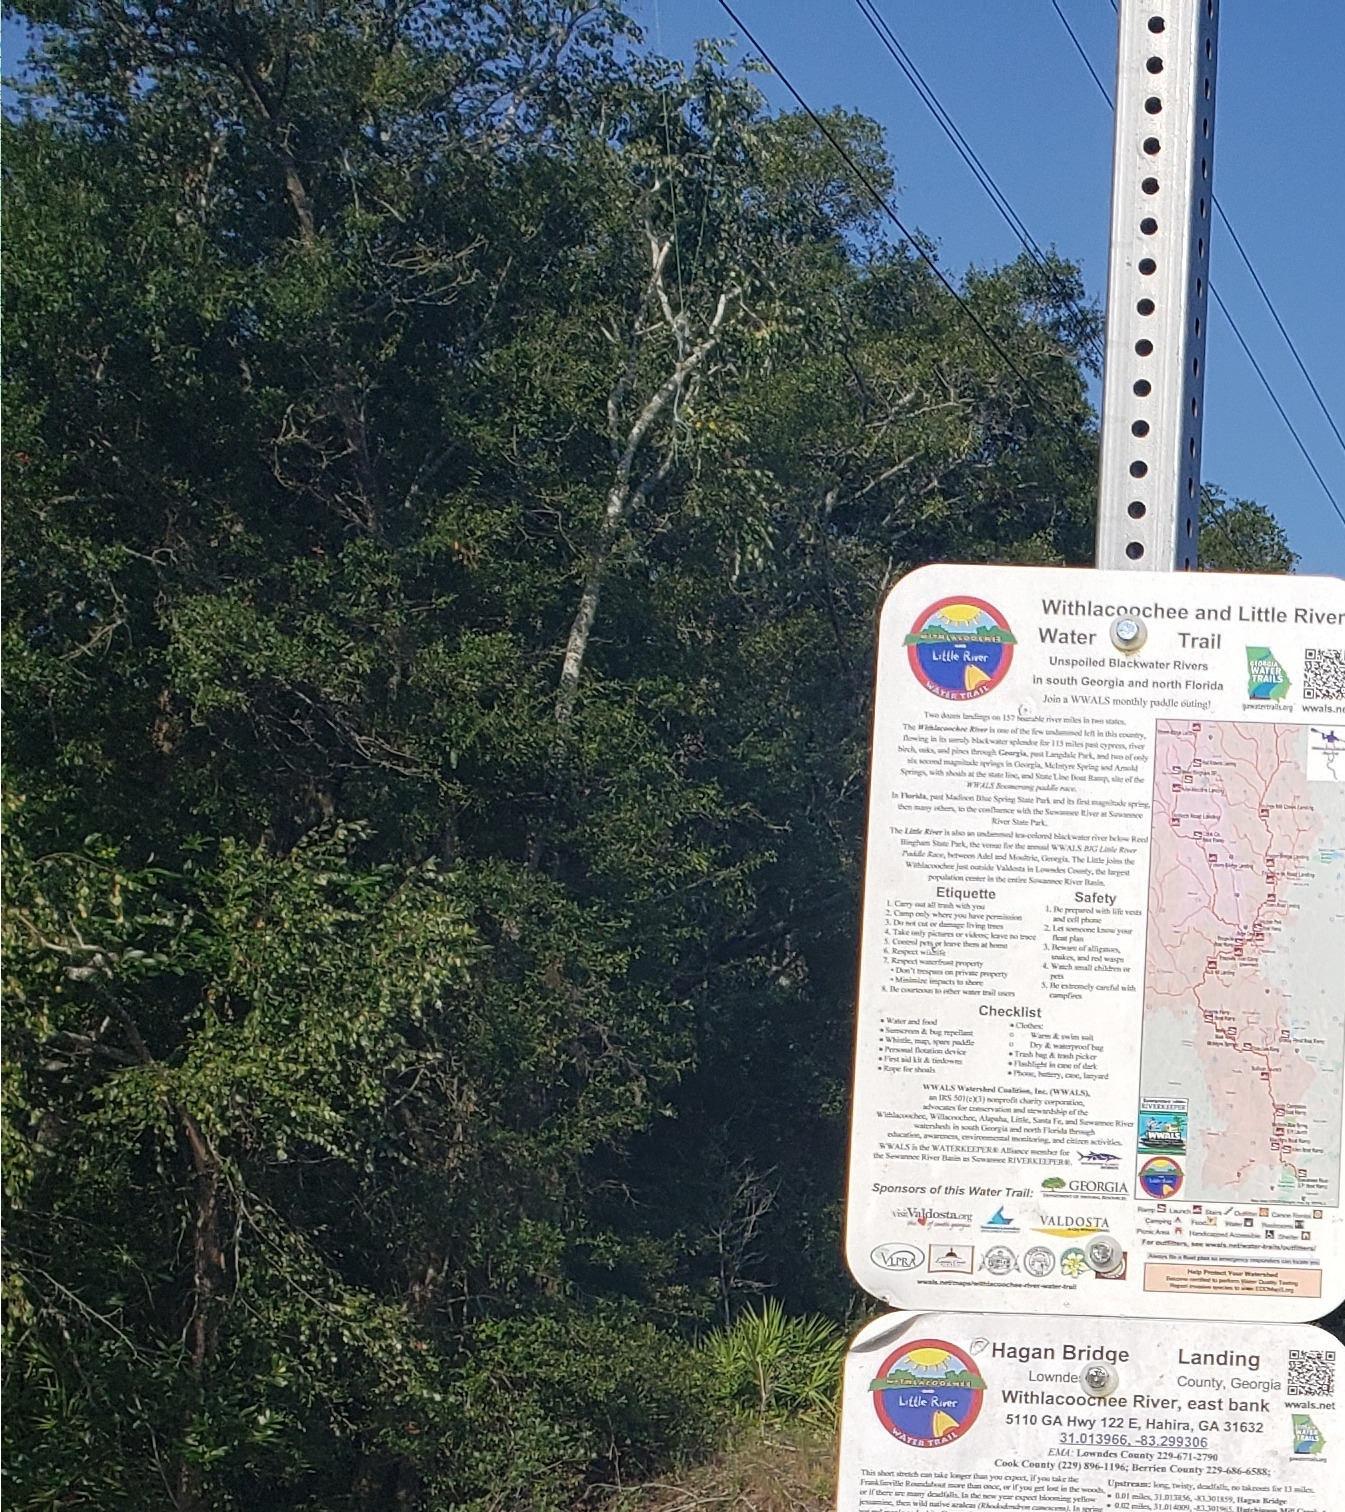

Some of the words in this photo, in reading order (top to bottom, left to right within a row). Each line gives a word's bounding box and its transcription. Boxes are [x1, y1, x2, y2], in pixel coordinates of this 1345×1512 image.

[1042, 599, 1188, 619] Withlacoochee
[1195, 605, 1231, 620] and
[1239, 606, 1286, 622] Little
[1294, 608, 1345, 624] River
[1038, 627, 1096, 644] Water
[1178, 632, 1220, 648] Trail
[932, 650, 959, 662] Little
[963, 651, 989, 663] River
[1049, 656, 1105, 668] Unspoiled
[1109, 655, 1170, 669] Blackwater
[1173, 660, 1208, 670] Rivers
[1251, 667, 1281, 675] WATER
[1033, 674, 1042, 684] in
[1046, 676, 1077, 685] south
[1081, 676, 1124, 688] Georgia
[1128, 678, 1148, 687] and
[1152, 680, 1181, 688] north
[1185, 680, 1223, 690] Florida
[1252, 675, 1283, 683] TRAILS
[926, 680, 958, 699] WATER
[960, 685, 990, 699] TRAIL
[1042, 694, 1060, 702] Join
[1071, 695, 1110, 704] WWALS
[1112, 697, 1147, 708] monthly
[1150, 698, 1178, 708] paddle
[1180, 699, 1210, 710] outing!
[936, 886, 995, 900] Etiquette
[1074, 891, 1116, 906] Safety
[979, 1005, 1041, 1017] Checklist
[1148, 1131, 1180, 1140] WWALS
[871, 1183, 926, 1194] Sponsors
[929, 1185, 942, 1194] of
[944, 1185, 964, 1195] this
[969, 1186, 1002, 1196] Water
[1005, 1187, 1033, 1197] Trail:
[1069, 1180, 1127, 1194] GEORGIA
[1039, 1215, 1108, 1229] VALDOSTA
[992, 1342, 1054, 1362] Hagan
[1063, 1344, 1129, 1364] Bridge
[1179, 1348, 1259, 1370] Landing
[1178, 1376, 1227, 1390] County,
[1231, 1378, 1280, 1392] Georgia
[899, 1396, 927, 1407] Little
[931, 1397, 958, 1408] River
[1133, 1394, 1181, 1411] River,
[1187, 1398, 1223, 1410] east
[1229, 1398, 1269, 1412] bank
[1284, 1401, 1336, 1410] wwals.net
[1006, 1414, 1037, 1425] 5110
[1041, 1414, 1062, 1425] GA
[1067, 1416, 1096, 1430] Hwy
[1101, 1417, 1123, 1428] 122
[1128, 1418, 1141, 1430] E,
[1146, 1418, 1193, 1432] Hahira,
[1198, 1420, 1219, 1431] GA
[1223, 1421, 1263, 1432] 31632
[893, 1427, 924, 1446] WATER
[927, 1432, 957, 1446] TRAIL
[1060, 1433, 1131, 1446] 31.013966,
[1136, 1436, 1208, 1448] -83.299306
[1048, 1448, 1073, 1456] EMA:
[1077, 1448, 1117, 1457] Lowndes
[1120, 1450, 1154, 1461] County
[1157, 1451, 1218, 1461] 229-671-2790
[994, 1458, 1018, 1467] Cook
[1021, 1460, 1055, 1470] County
[1058, 1462, 1081, 1471] (229)
[1084, 1463, 1129, 1472] 896-1196;
[1132, 1463, 1166, 1472] Berrien
[1169, 1465, 1203, 1475] County
[1206, 1466, 1270, 1476] 229-686-6588;
